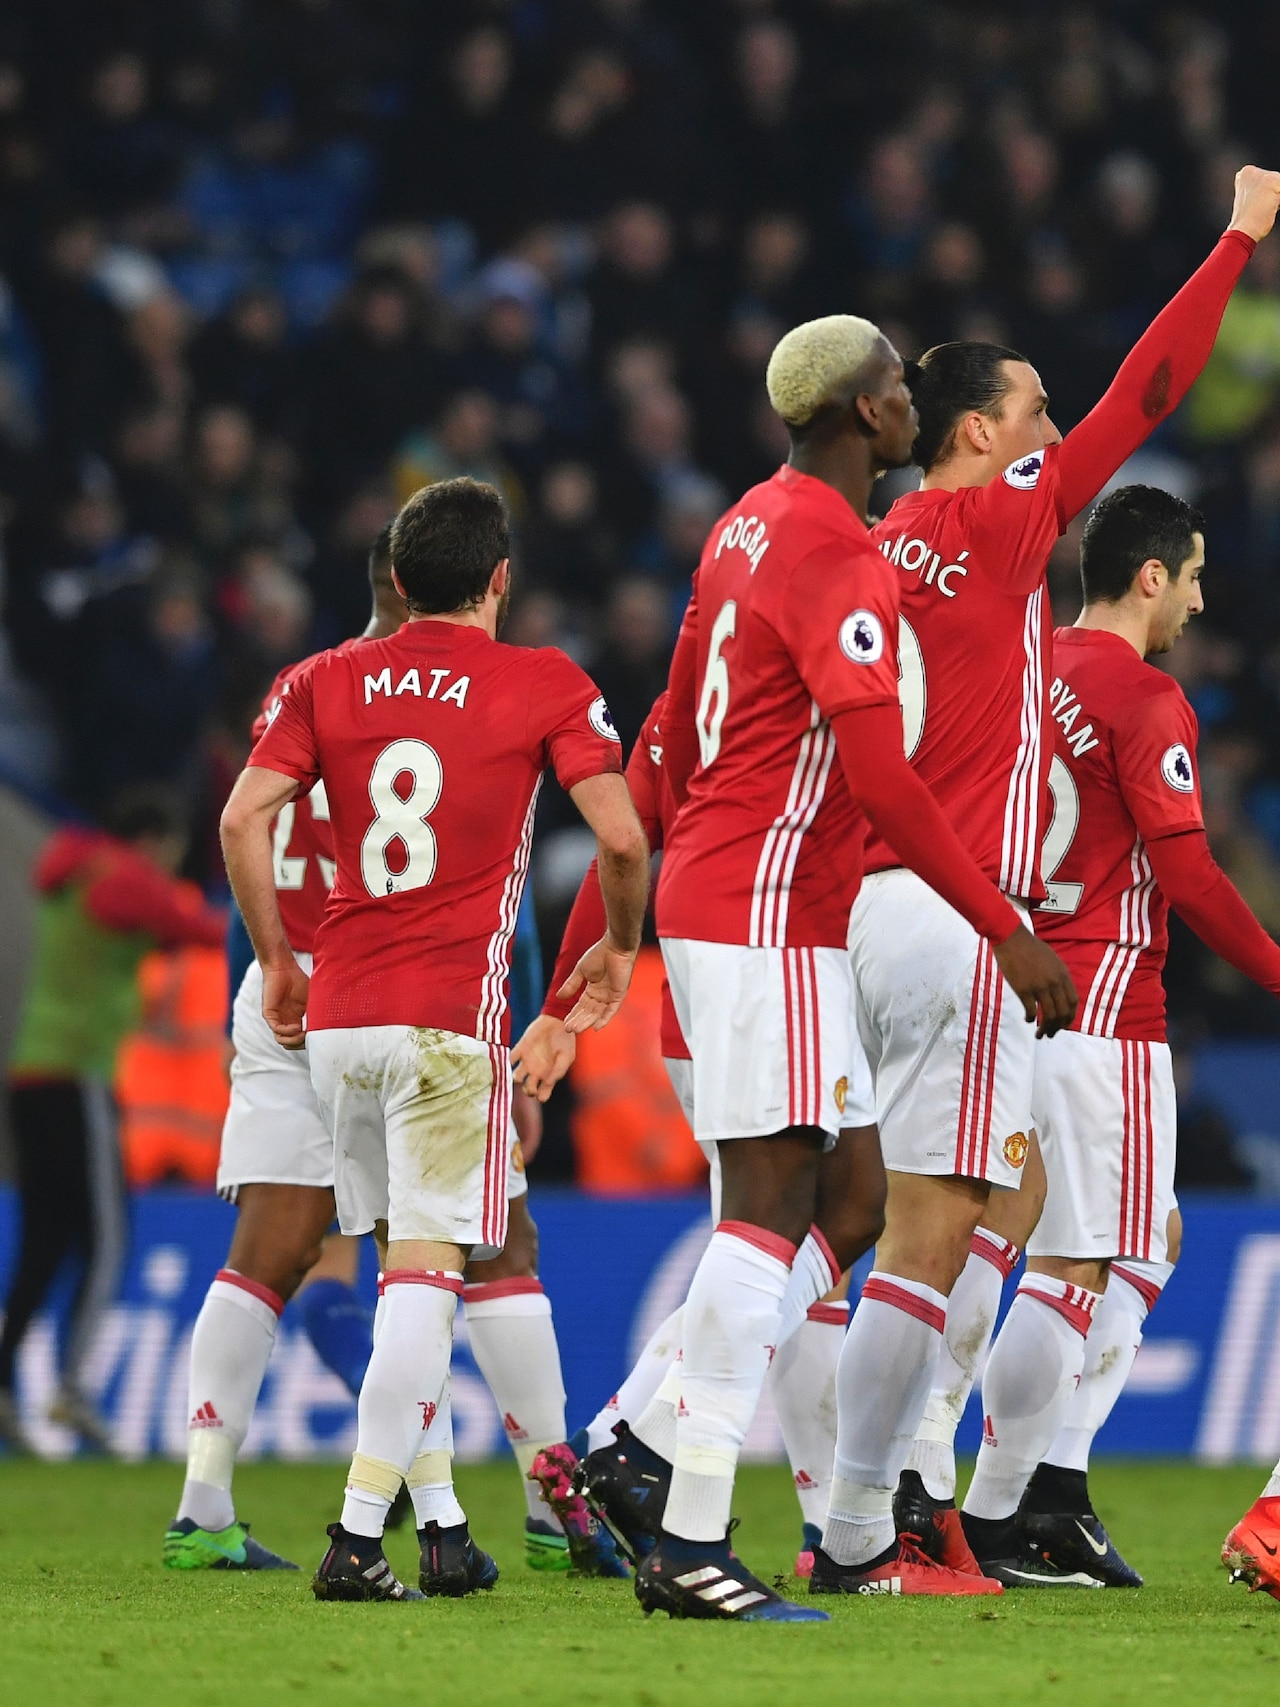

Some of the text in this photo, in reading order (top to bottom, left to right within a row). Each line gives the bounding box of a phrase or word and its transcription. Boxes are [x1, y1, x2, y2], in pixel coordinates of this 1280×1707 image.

[715, 516, 770, 575] POGBA
[364, 667, 471, 709] MATA
[695, 599, 738, 769] 6
[360, 737, 443, 899] 8
